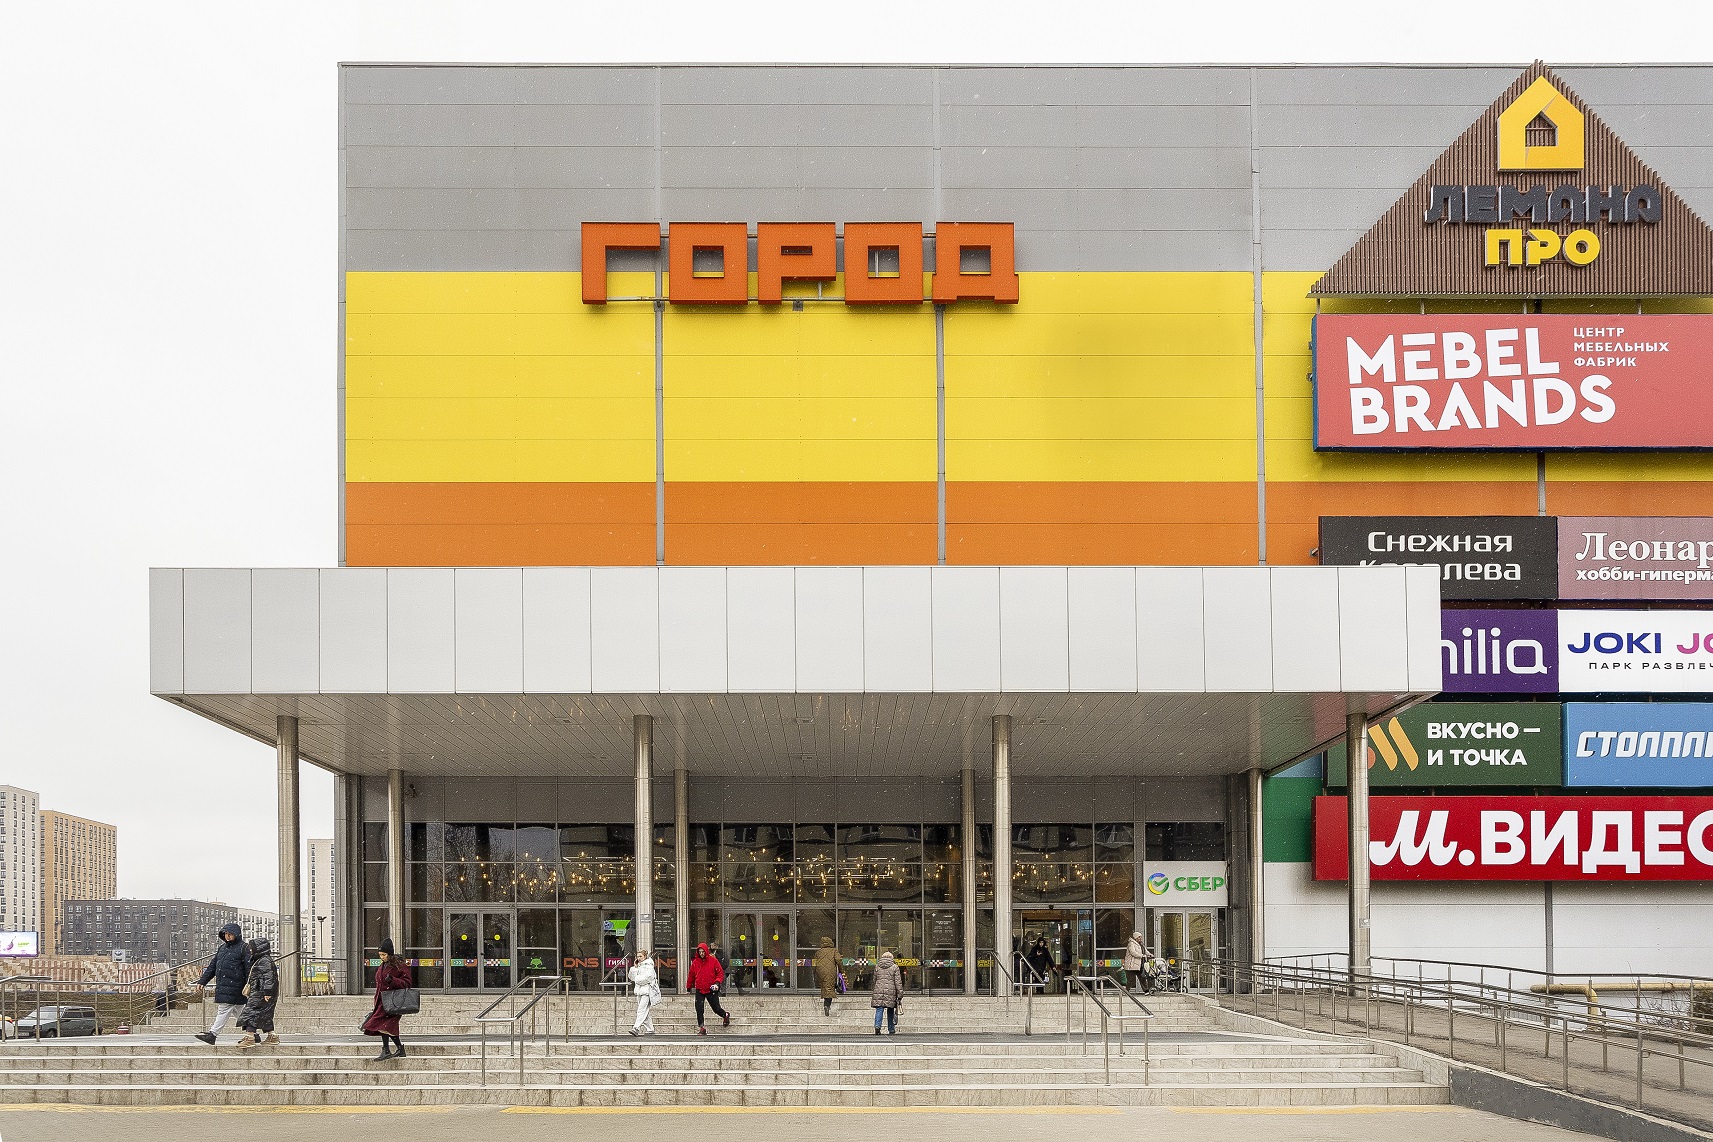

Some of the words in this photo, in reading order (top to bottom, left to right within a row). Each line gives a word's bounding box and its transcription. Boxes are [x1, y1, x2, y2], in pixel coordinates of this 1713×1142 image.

[1425, 185, 1662, 223] ЛЕМАНА
[1485, 229, 1600, 267] ПРО
[581, 222, 1019, 304] ГОРОД
[1573, 327, 1625, 340] ЦЕНТР
[1346, 327, 1560, 385] MEBEL
[1573, 341, 1670, 353] МЕБЕЛЬНЫХ
[1573, 356, 1637, 367] ФАБРИК
[1350, 375, 1617, 435] BRANDS
[1368, 531, 1513, 552] Снежная
[1359, 560, 1521, 580] лева
[1575, 566, 1713, 584] хобби-гиперм
[1567, 632, 1662, 654] JOKI
[1589, 662, 1632, 670] ПАРК
[1427, 722, 1519, 739] ВКУСНО
[1427, 749, 1443, 766] И
[1450, 749, 1528, 766] ТОЧКА
[1174, 876, 1226, 891] СБЕР
[563, 957, 599, 968] DNS
